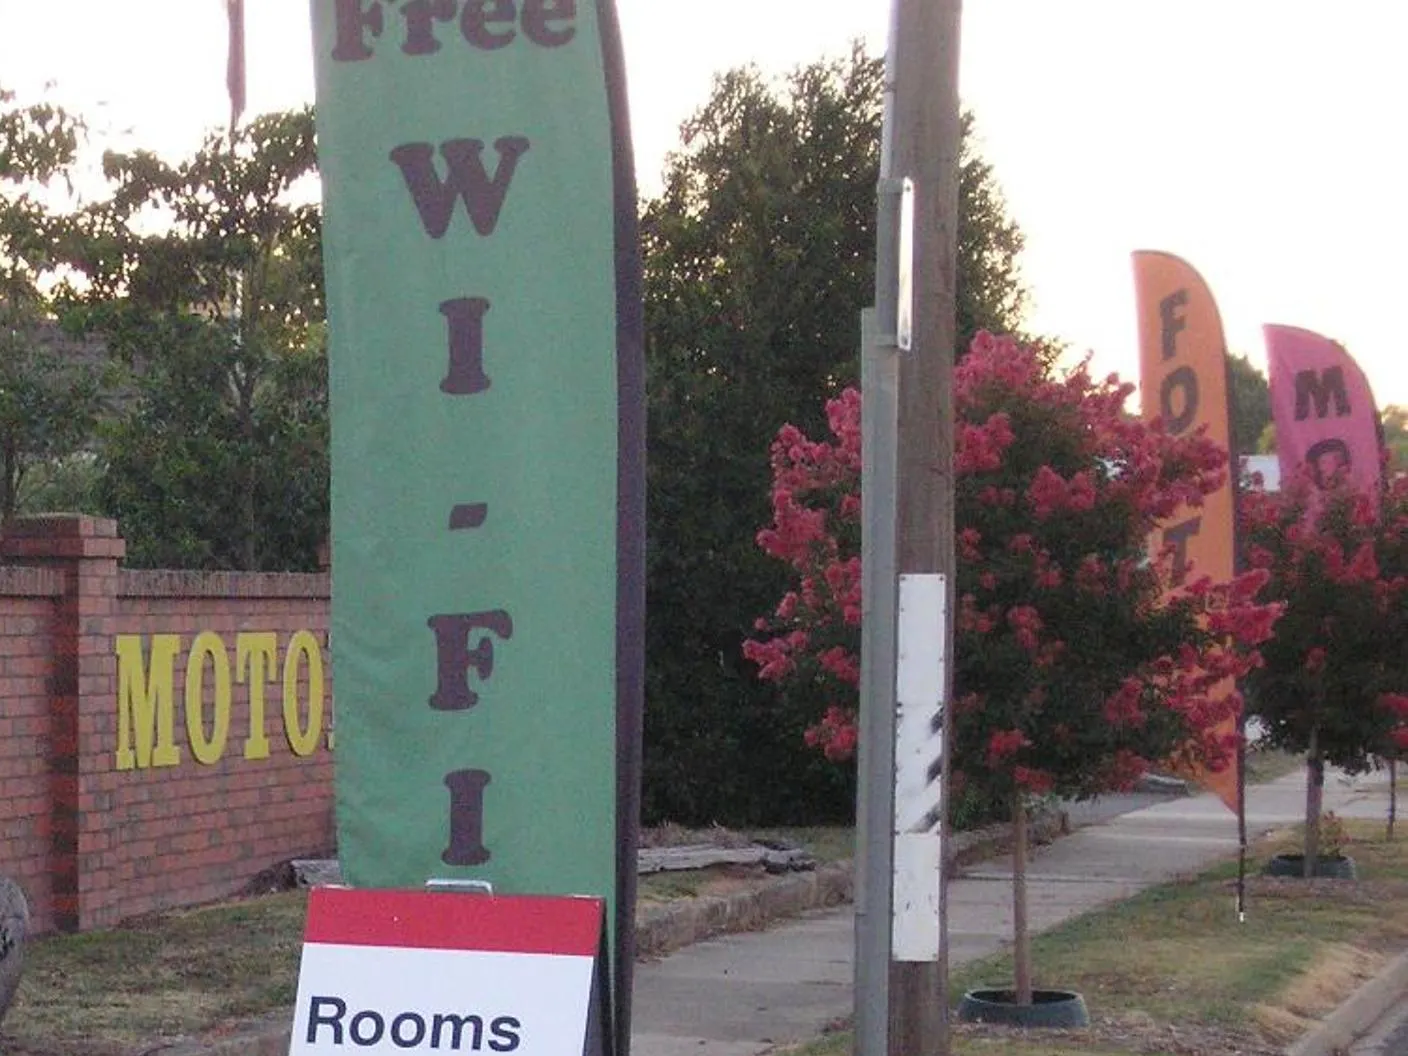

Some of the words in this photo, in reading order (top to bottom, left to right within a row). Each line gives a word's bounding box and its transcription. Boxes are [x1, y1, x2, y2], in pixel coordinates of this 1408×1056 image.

[331, 0, 577, 61] Free
[1158, 288, 1202, 588] FOT
[115, 629, 335, 771] MOTO
[305, 995, 522, 1053] Rooms
